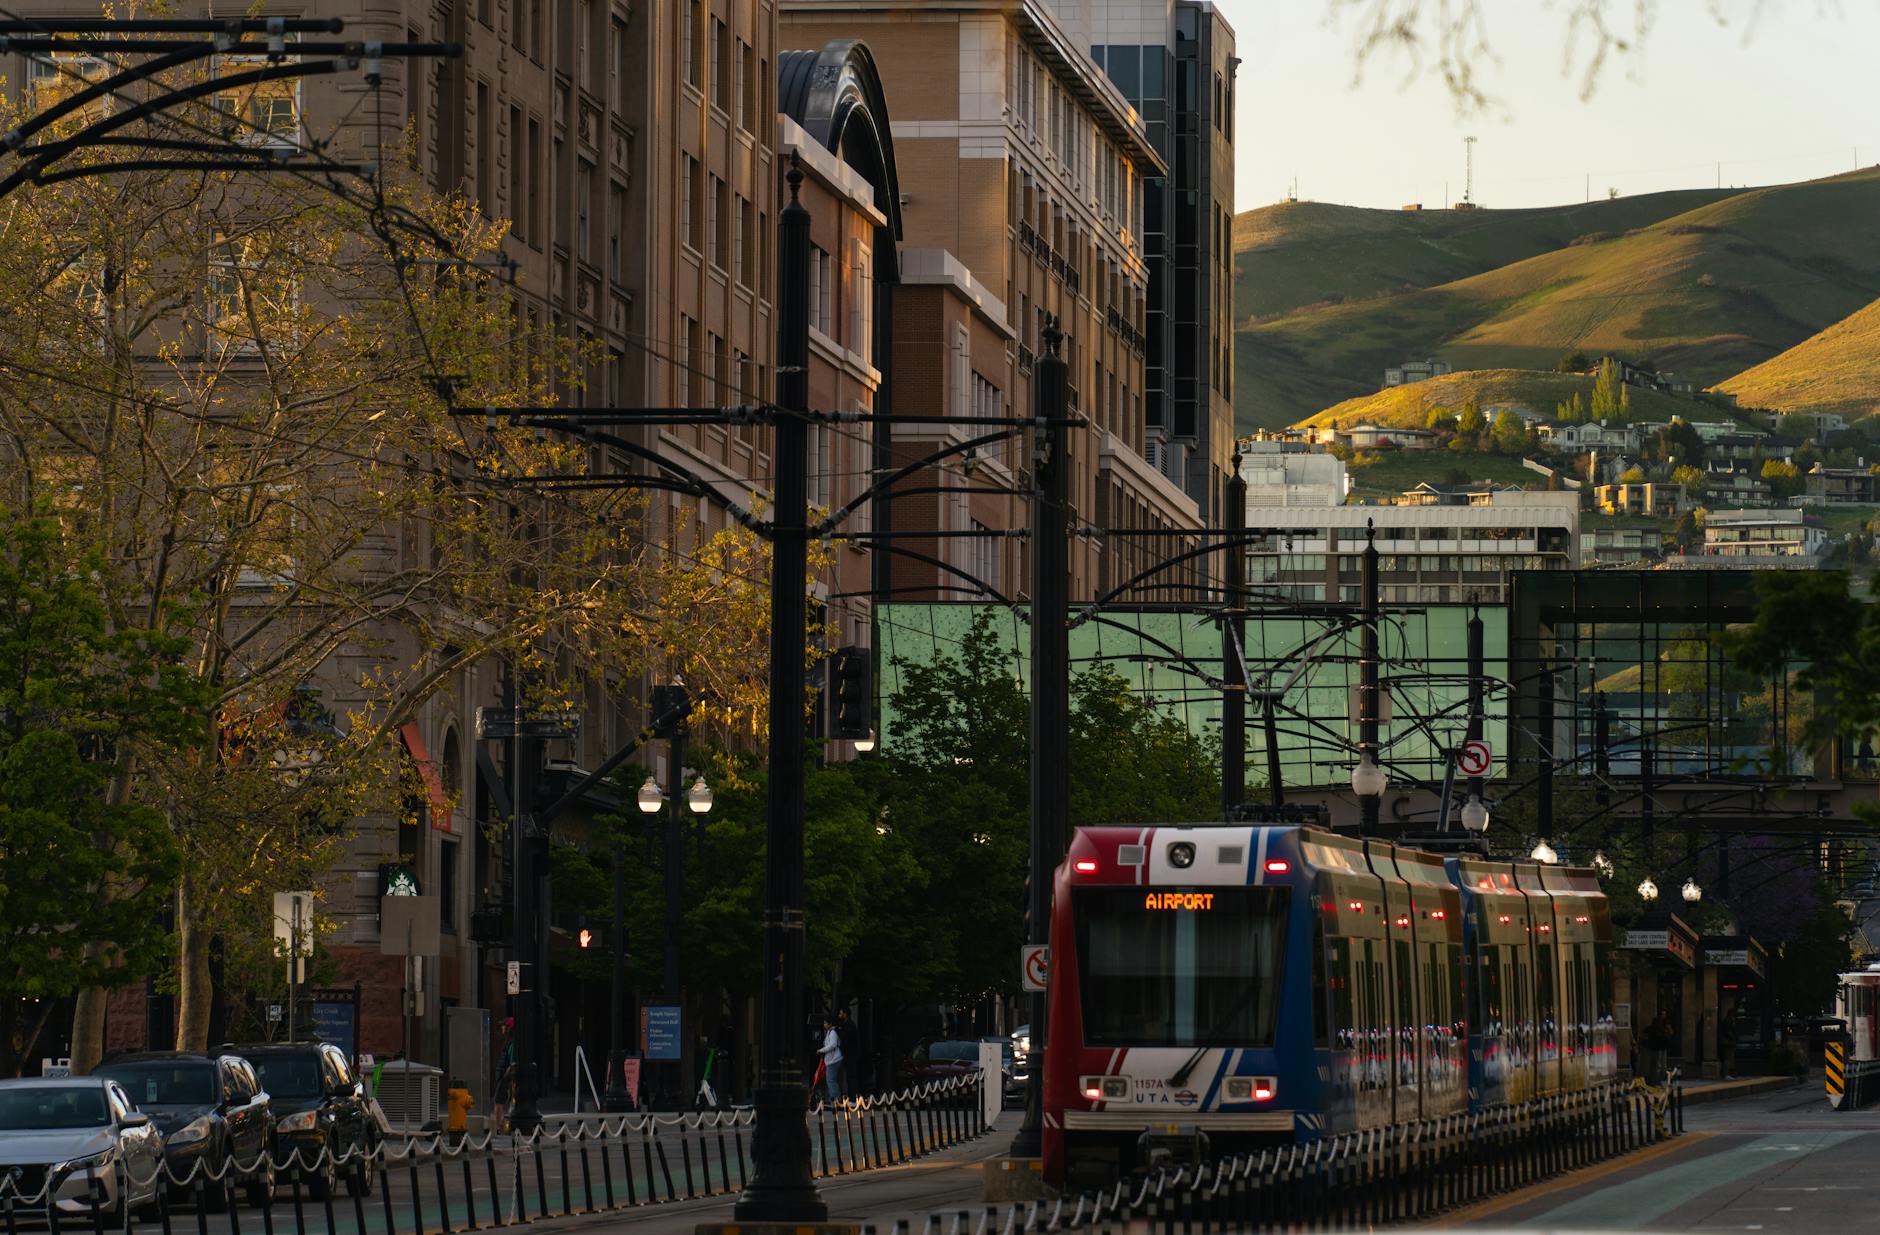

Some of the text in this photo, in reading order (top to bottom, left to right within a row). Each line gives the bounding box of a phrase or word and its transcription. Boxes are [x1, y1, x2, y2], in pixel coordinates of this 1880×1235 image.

[1145, 893, 1214, 910] AIRPORT
[1135, 1079, 1164, 1089] 1157A
[1136, 1093, 1169, 1103] UTA
